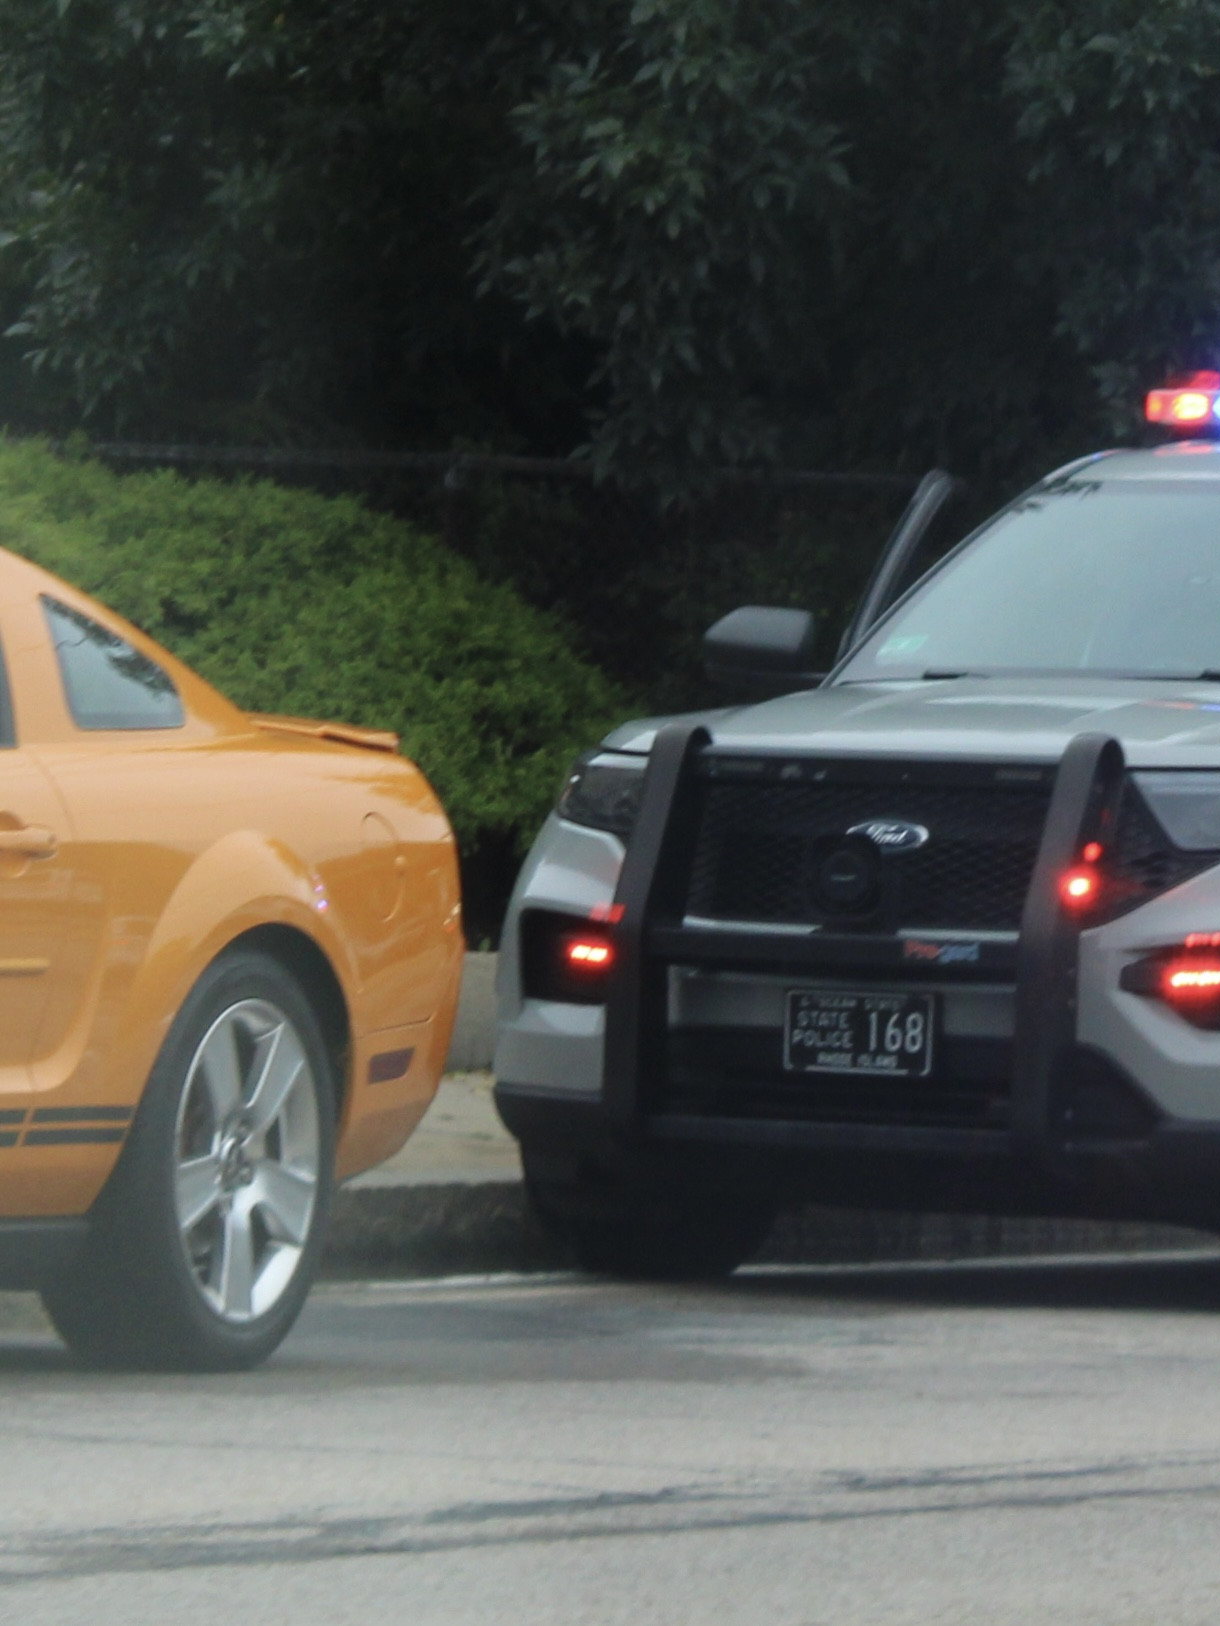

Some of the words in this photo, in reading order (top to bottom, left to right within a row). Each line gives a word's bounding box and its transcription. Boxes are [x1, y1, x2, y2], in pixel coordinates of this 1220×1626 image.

[865, 823, 907, 845] Ford
[797, 1010, 849, 1030] STATE
[792, 1028, 854, 1049] POLICE
[868, 1011, 924, 1054] 168
